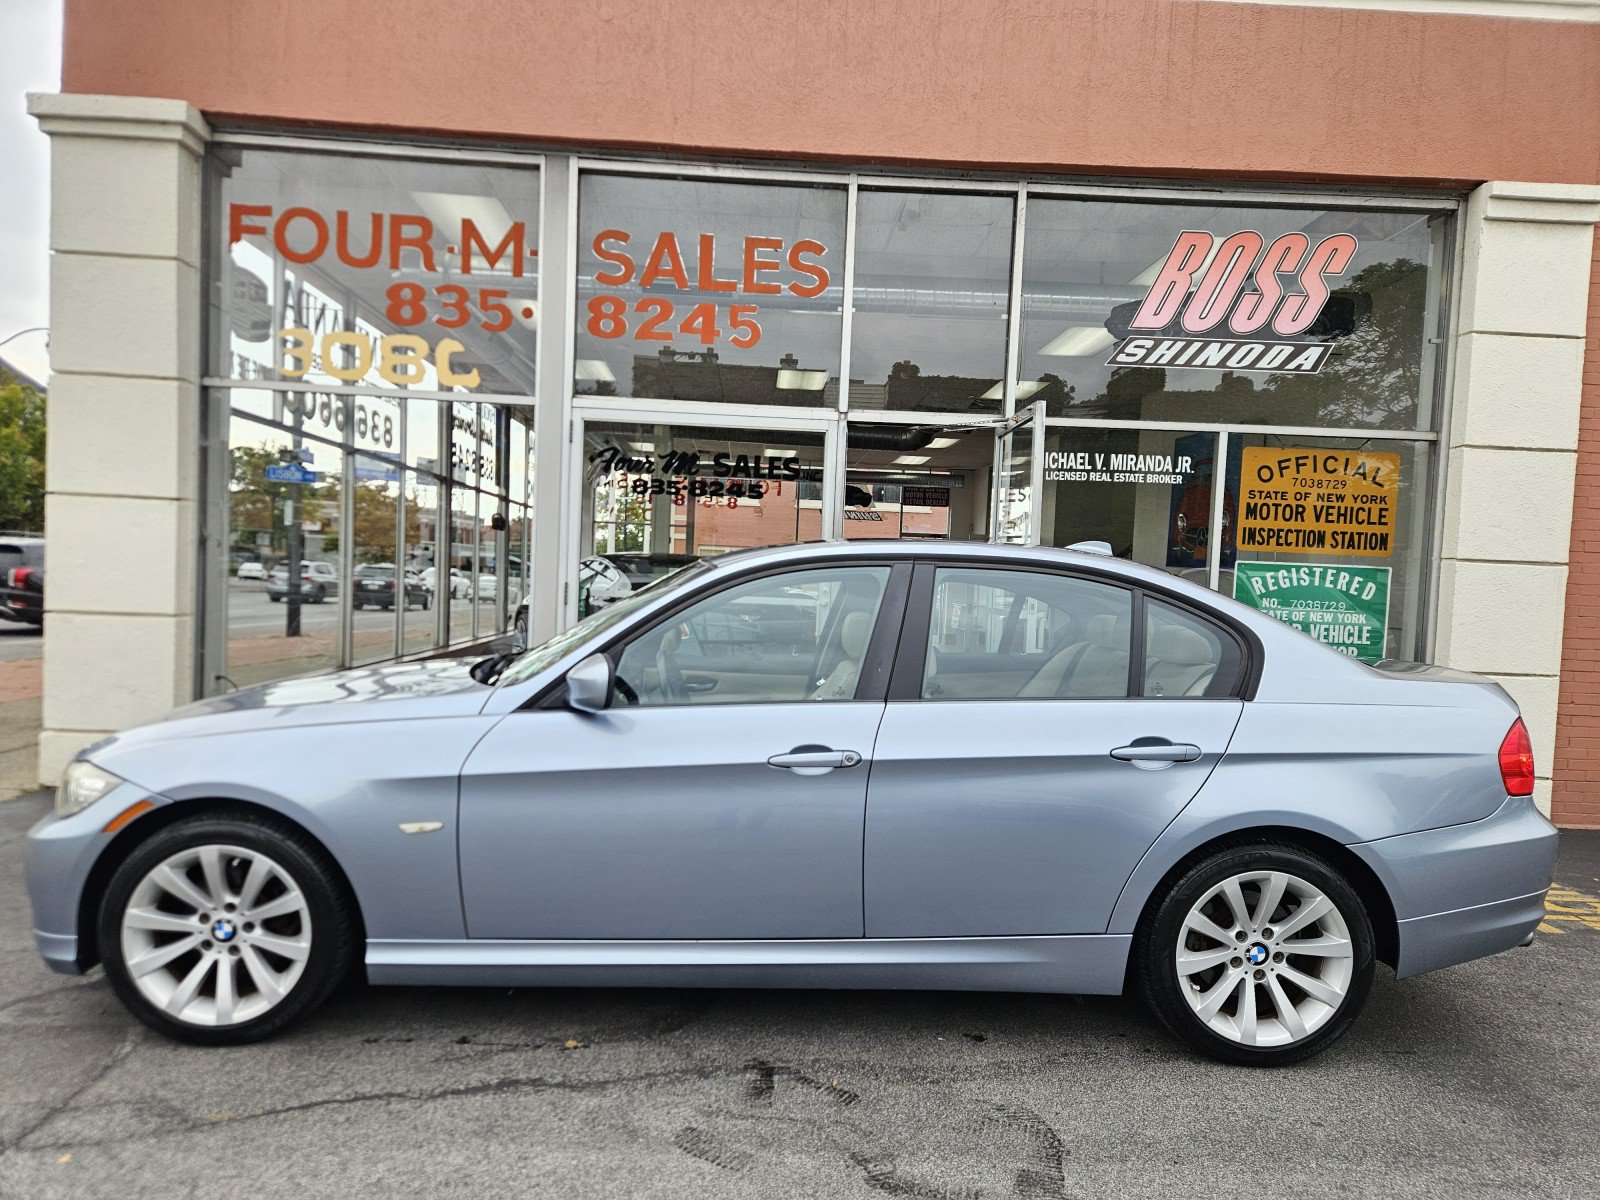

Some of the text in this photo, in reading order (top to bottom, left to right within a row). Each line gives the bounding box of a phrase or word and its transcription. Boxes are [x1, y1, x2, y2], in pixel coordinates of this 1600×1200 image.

[592, 229, 830, 298] SALES
[1129, 229, 1358, 336] BOSS
[587, 295, 762, 348] 8245
[1115, 339, 1325, 371] SHINODA
[588, 447, 655, 474] Four
[658, 449, 699, 475] M
[713, 453, 800, 481] SALES
[1045, 452, 1195, 474] ICHAEL V. MIRANDA JR.
[1257, 454, 1386, 488] OFFICIAL
[1045, 471, 1183, 484] LICENSED REAL ESTATE BROKER
[1292, 477, 1347, 490] 7038729
[1248, 490, 1388, 505] STATE OF NEW YORK
[1245, 502, 1390, 526] MOTOR VEHICLE
[1241, 526, 1389, 551] INSPECTION STATION
[1251, 566, 1377, 601] REGISTERED
[1262, 597, 1347, 611] NO. 7038729
[1292, 611, 1305, 621] OF
[1309, 611, 1337, 623] NEW
[1337, 613, 1367, 624] YORK
[1310, 624, 1372, 645] VEHICLE
